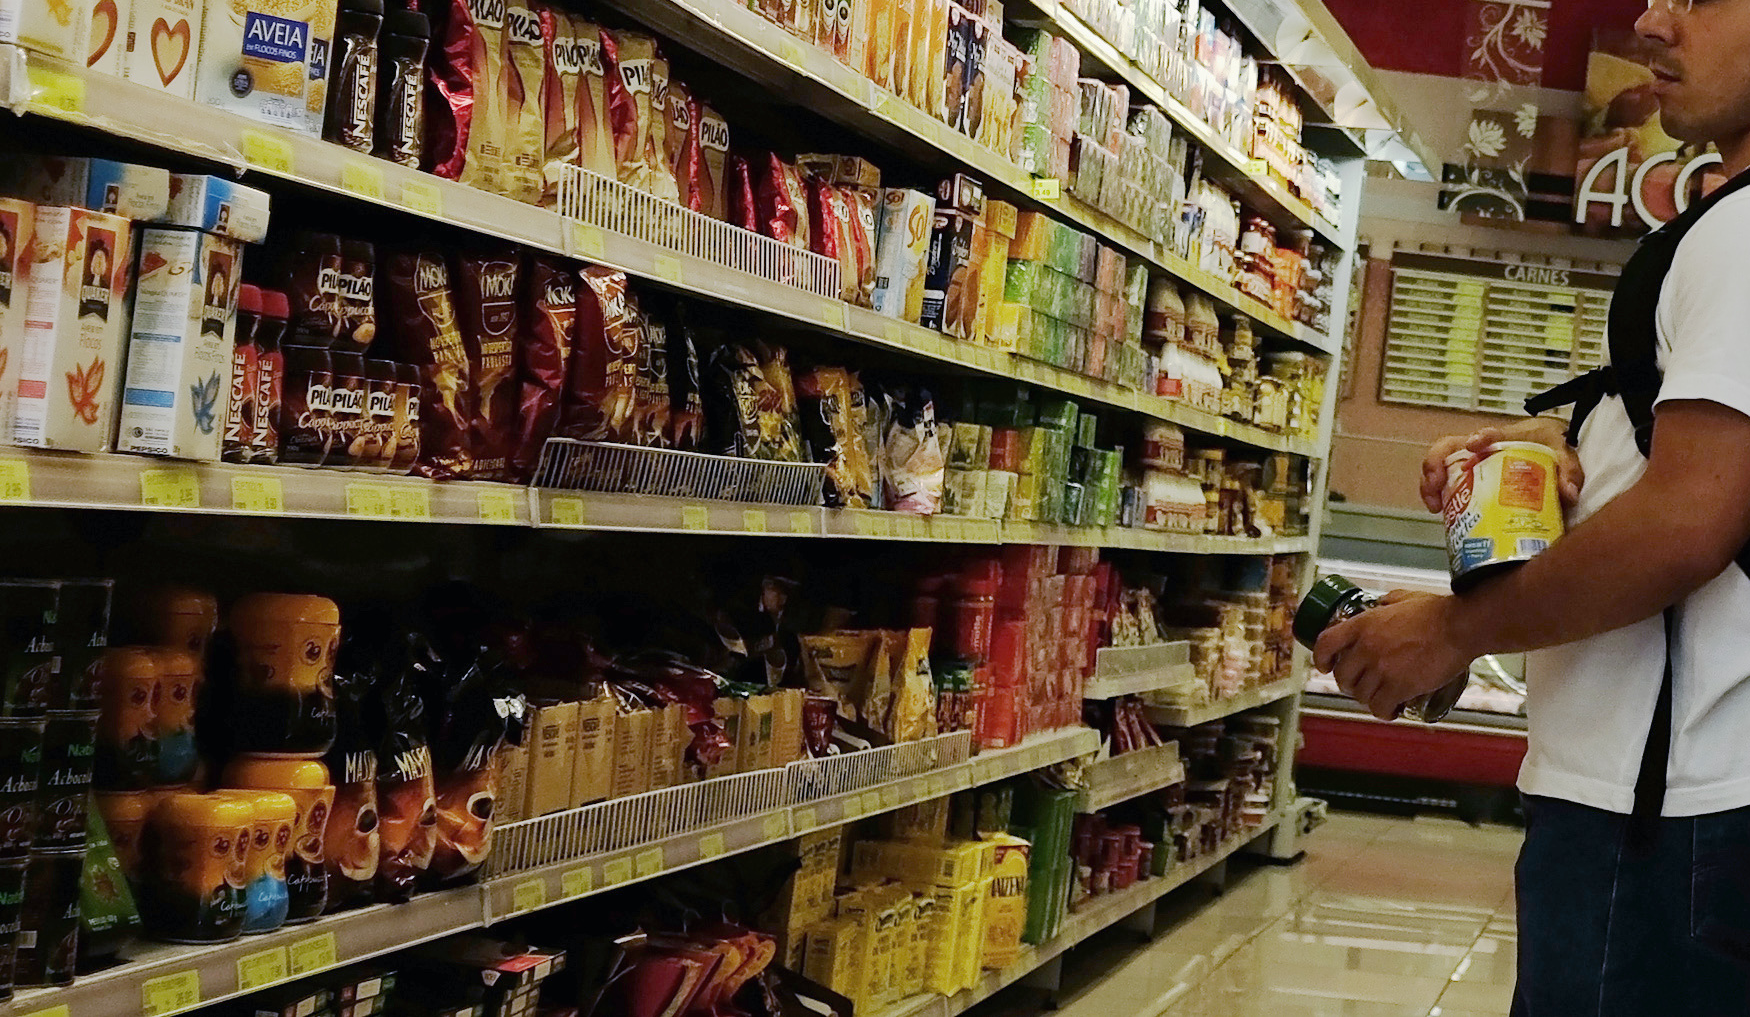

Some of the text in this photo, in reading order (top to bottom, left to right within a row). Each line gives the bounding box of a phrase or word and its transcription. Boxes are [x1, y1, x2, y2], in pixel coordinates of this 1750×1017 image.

[247, 18, 303, 49] AVEIA
[907, 204, 929, 249] Sol
[1504, 265, 1570, 286] CARNES
